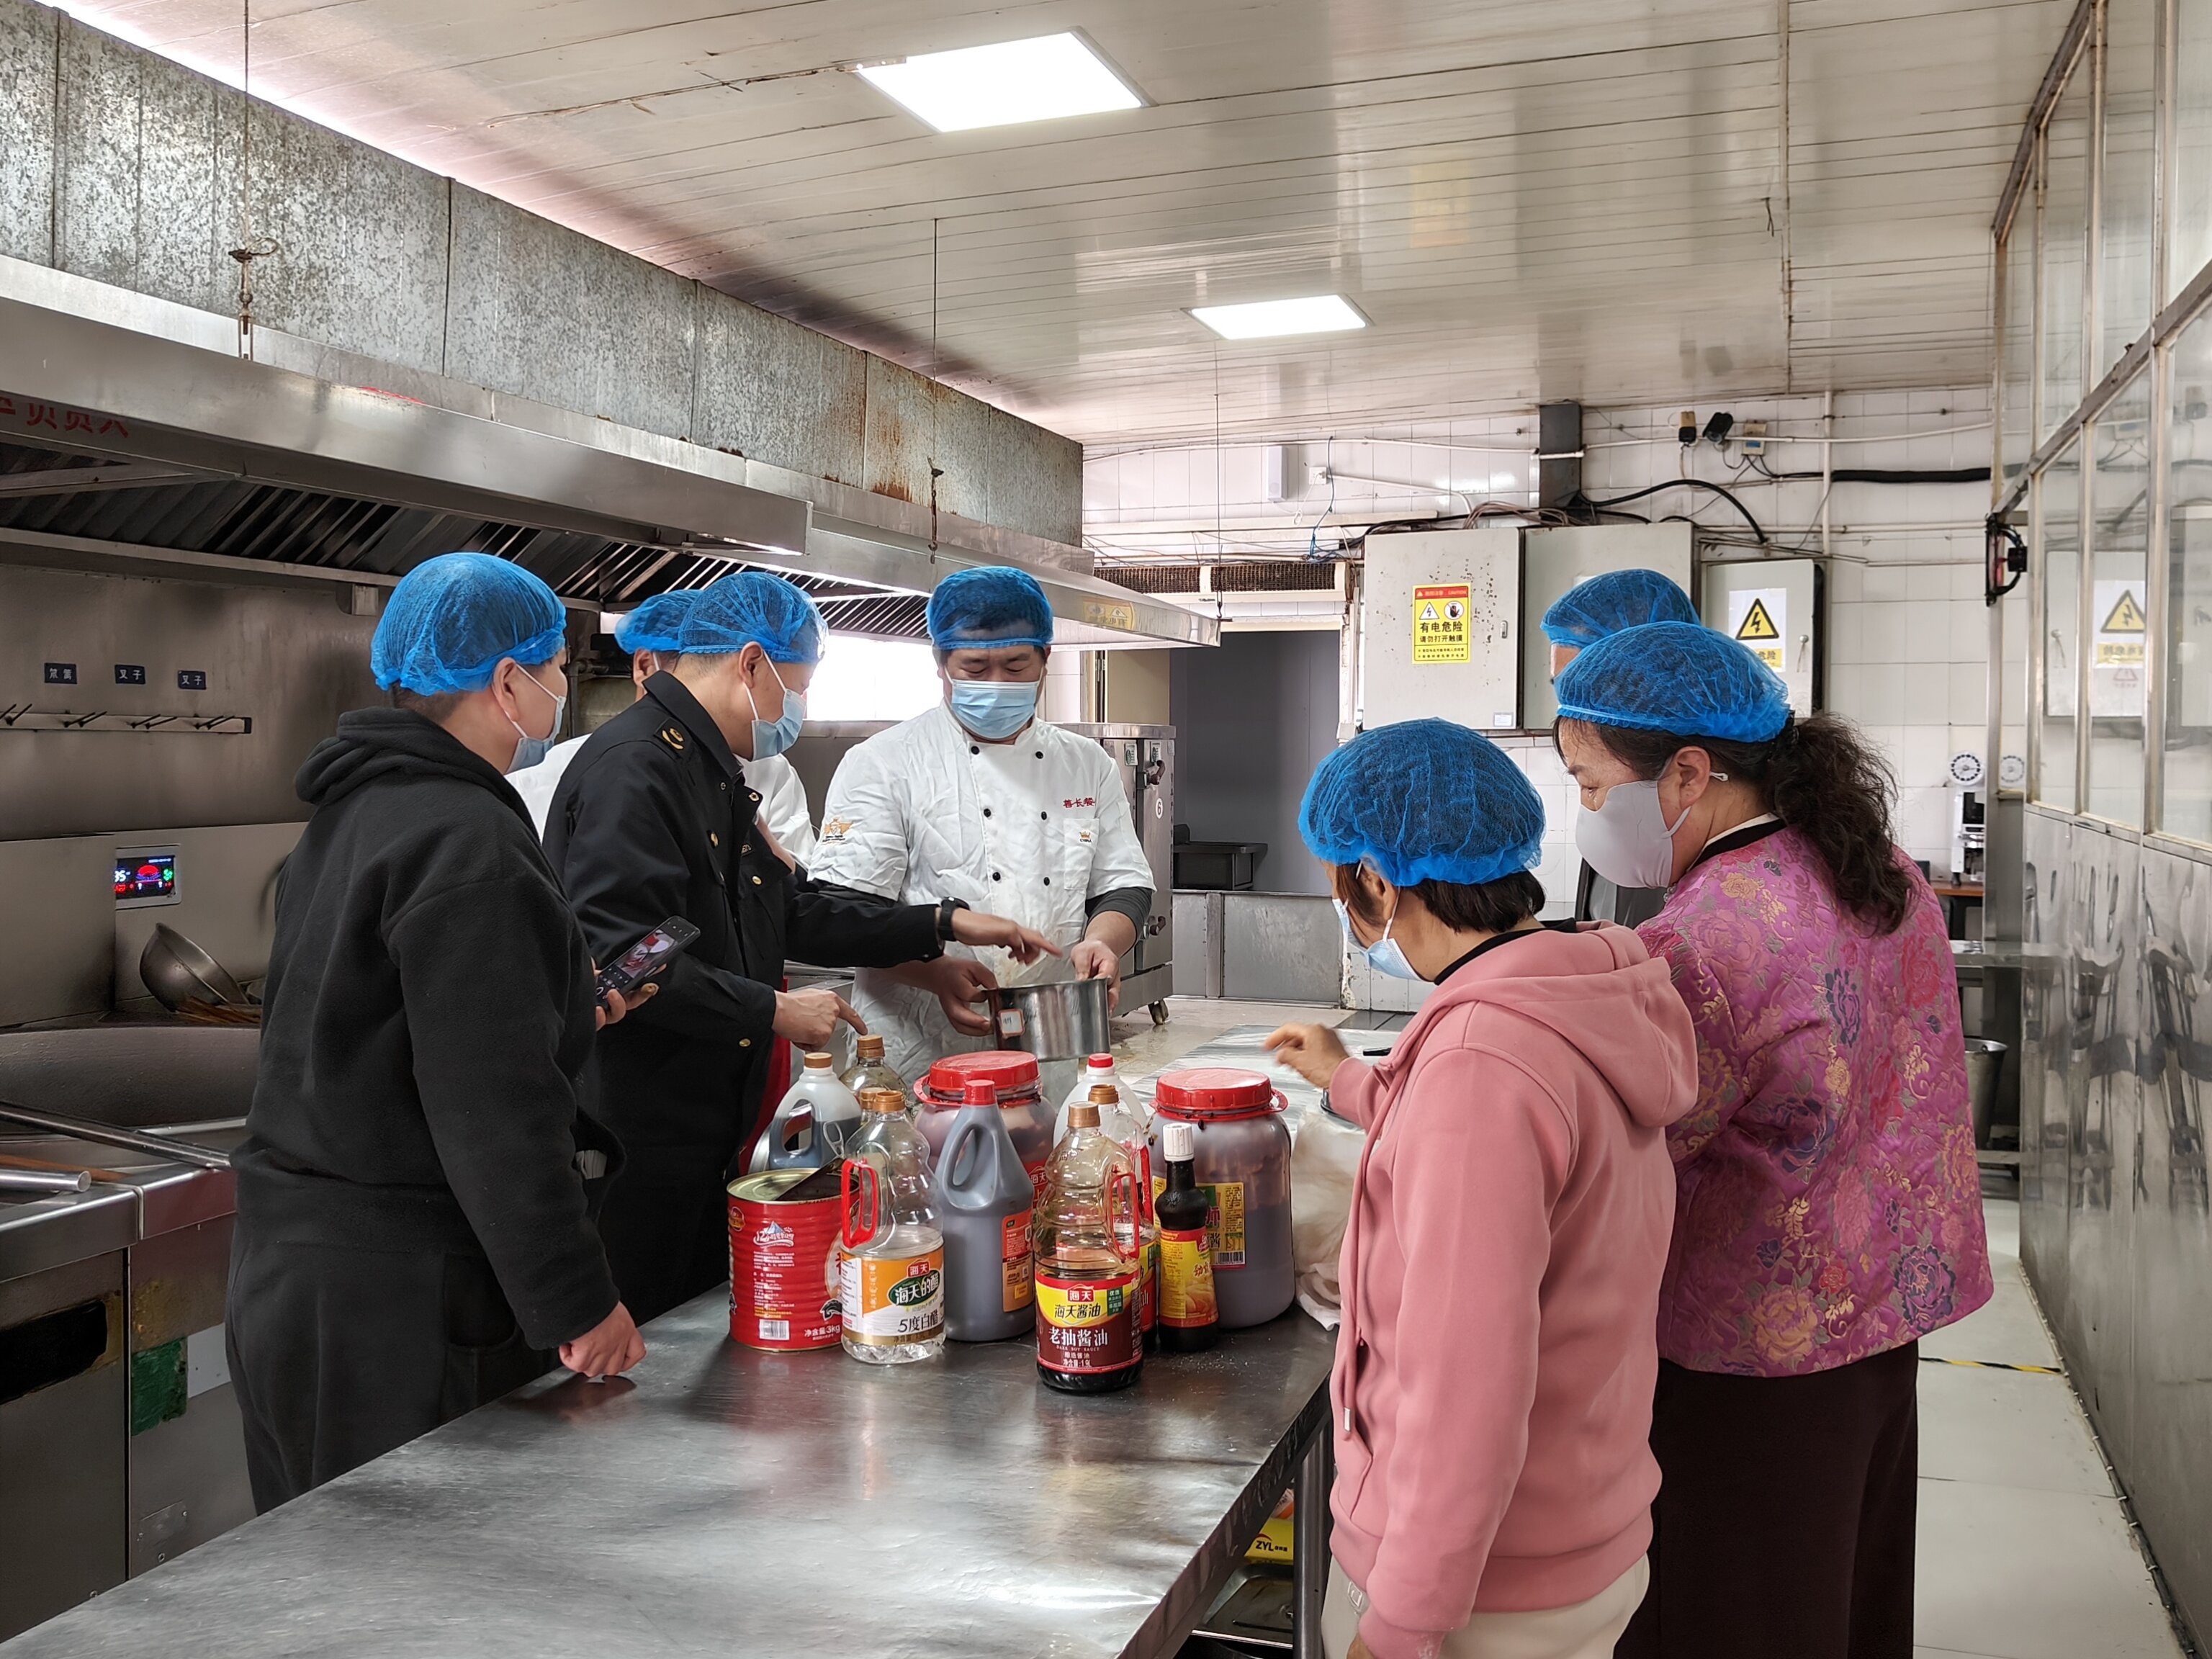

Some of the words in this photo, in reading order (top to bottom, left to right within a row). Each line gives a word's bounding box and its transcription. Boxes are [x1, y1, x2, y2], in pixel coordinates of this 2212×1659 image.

[1419, 621, 1463, 633] 有电危险
[1419, 634, 1462, 643] 请勿打开触摸
[118, 669, 142, 680] 叉子
[181, 675, 202, 685] 叉子
[909, 1263, 928, 1276] 海天
[895, 1272, 940, 1305] 海天的醋
[1069, 1290, 1092, 1301] 海天
[1055, 1303, 1101, 1318] 海天酱油
[898, 1310, 938, 1333] 5度白醋
[1049, 1326, 1108, 1346] 老抽酱油
[1255, 1540, 1274, 1552] ZYL
